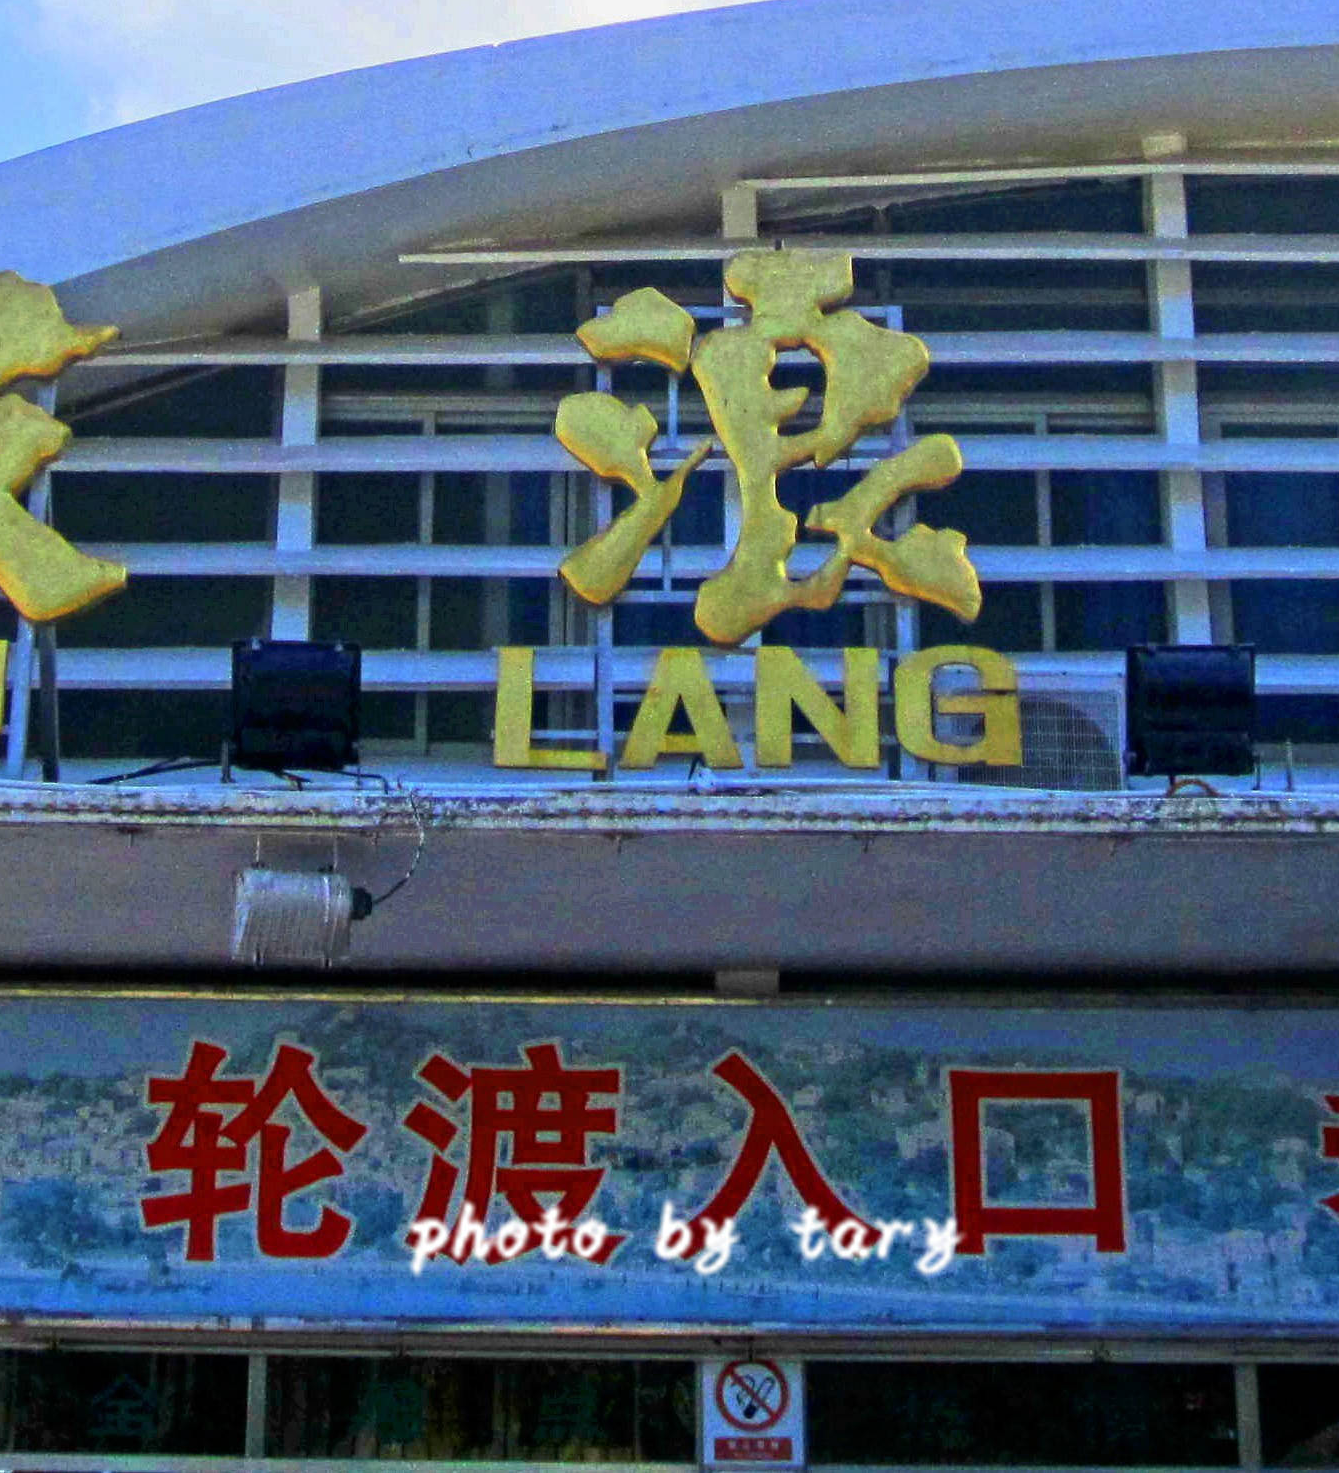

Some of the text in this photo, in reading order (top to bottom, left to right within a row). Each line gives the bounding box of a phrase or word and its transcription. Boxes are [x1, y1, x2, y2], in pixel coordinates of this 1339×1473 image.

[493, 645, 1022, 769] LANG
[141, 1040, 1127, 1265] 轮渡入口
